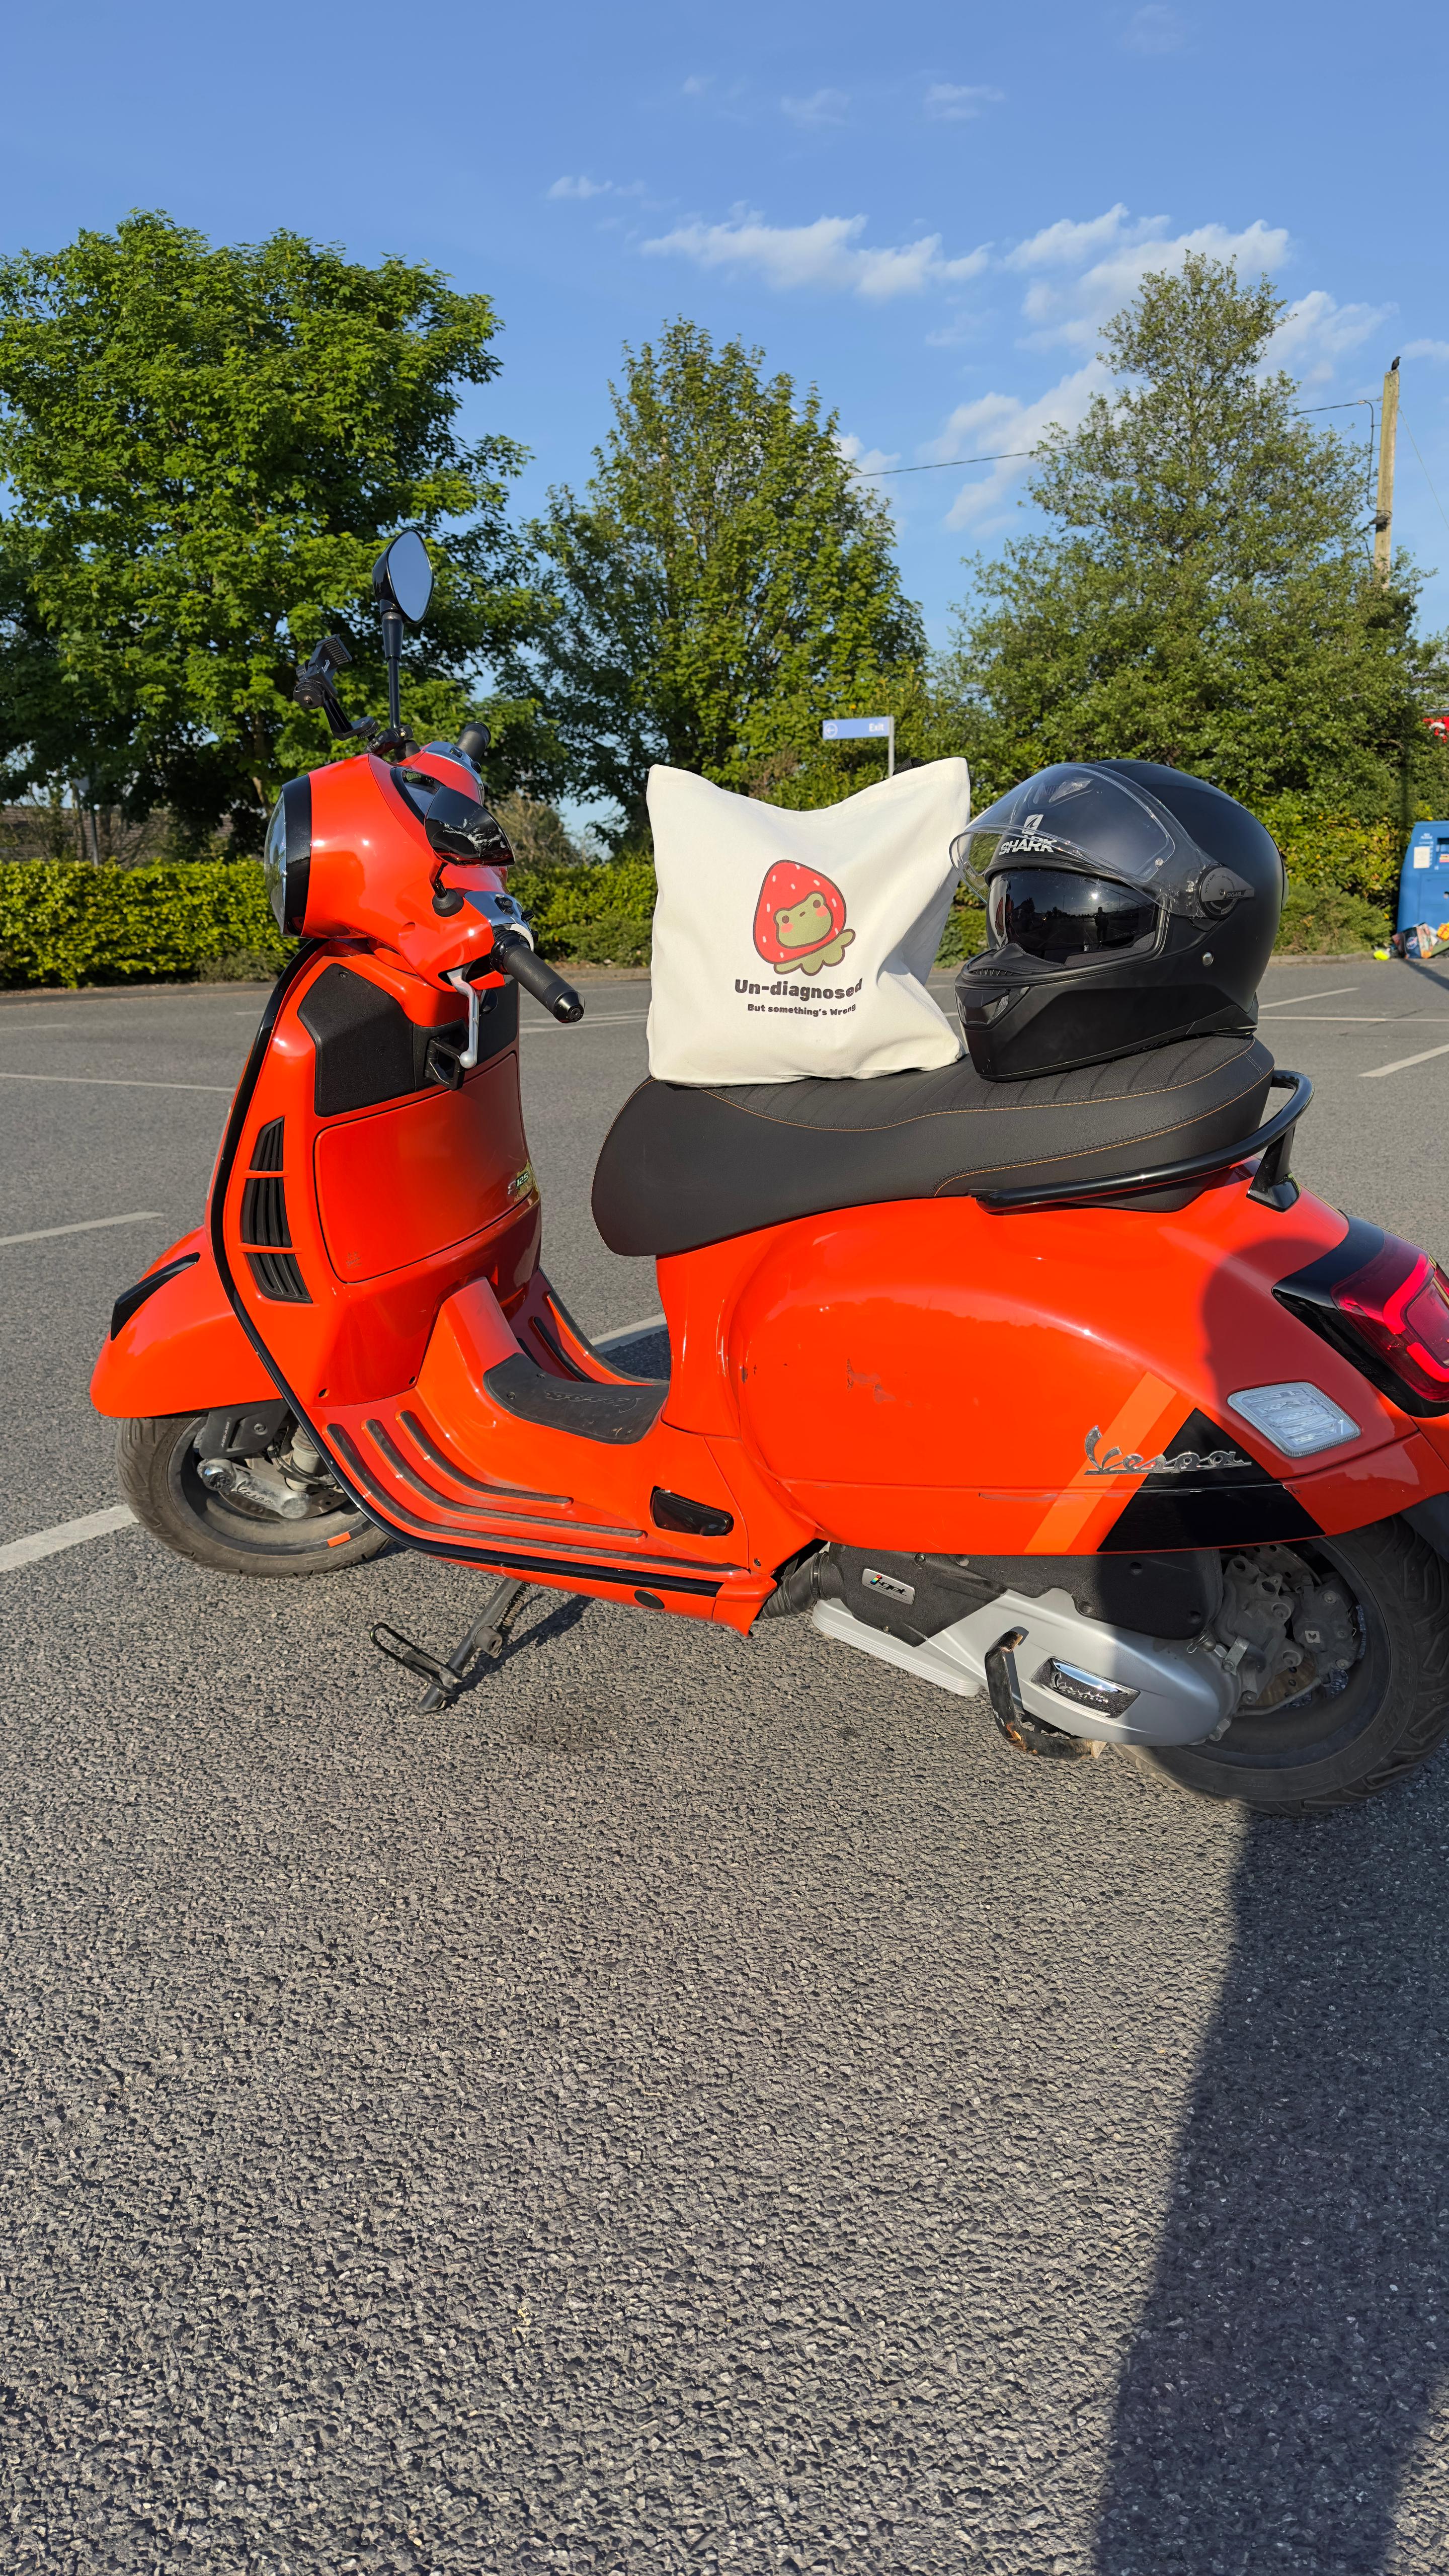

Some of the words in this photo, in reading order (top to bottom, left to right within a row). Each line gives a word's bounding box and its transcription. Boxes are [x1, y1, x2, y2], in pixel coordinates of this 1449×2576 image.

[999, 835, 1058, 855] SHARK
[735, 978, 863, 1001] Un-diagnosed
[747, 1003, 766, 1012] But
[767, 1006, 828, 1017] something's
[830, 1003, 856, 1016] Wrong
[516, 1172, 529, 1187] 125
[1083, 1425, 1252, 1476] Vespa
